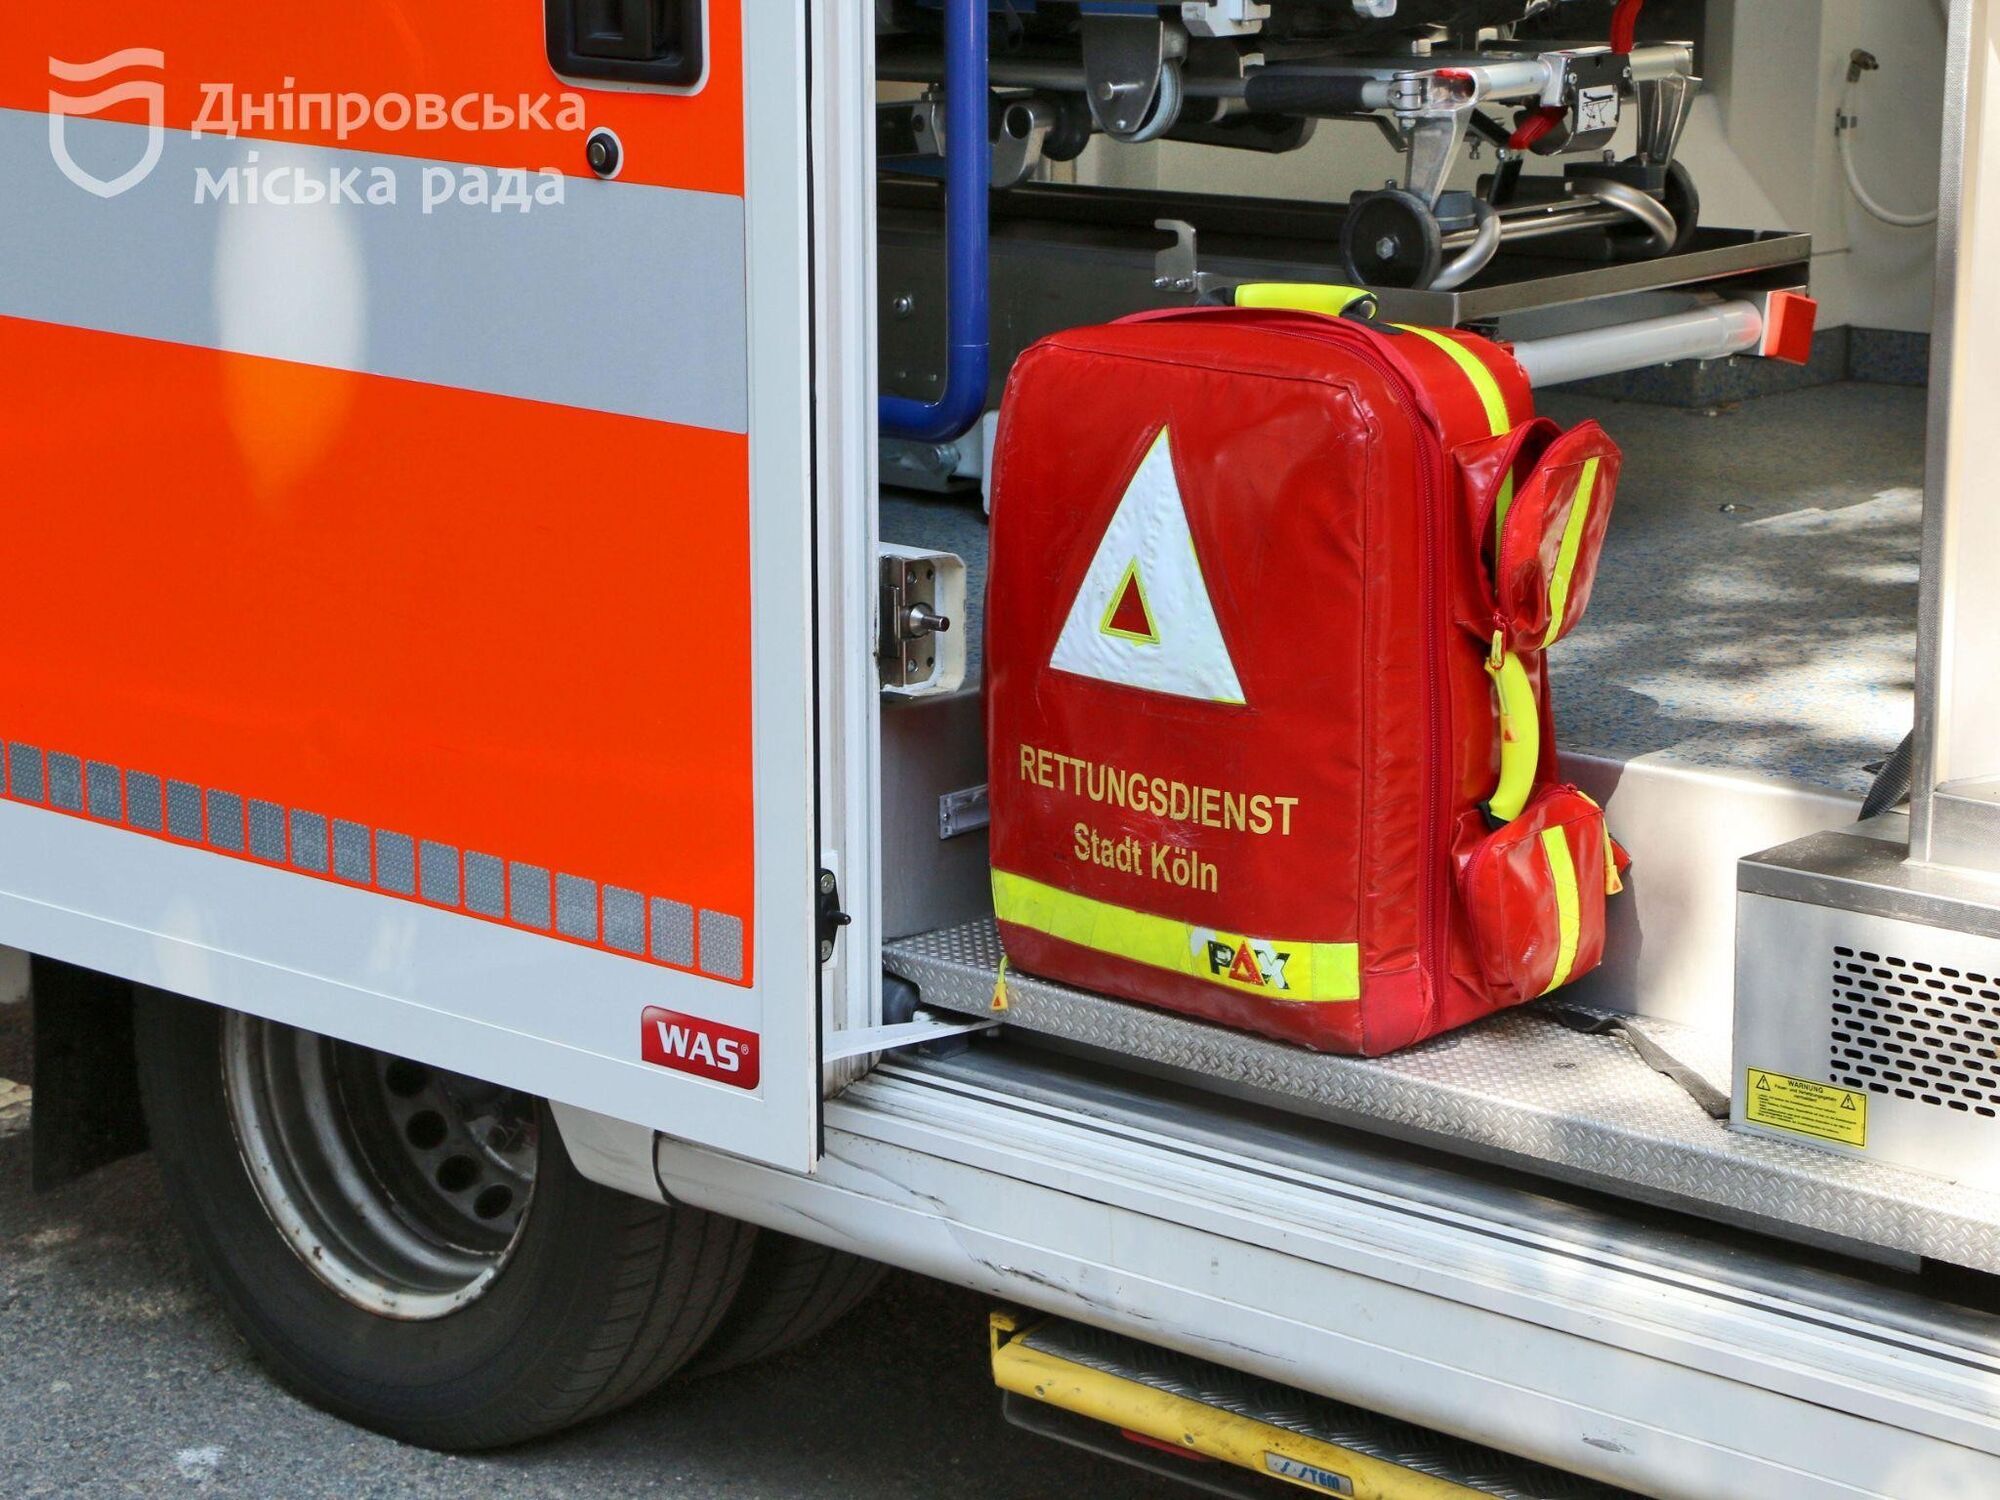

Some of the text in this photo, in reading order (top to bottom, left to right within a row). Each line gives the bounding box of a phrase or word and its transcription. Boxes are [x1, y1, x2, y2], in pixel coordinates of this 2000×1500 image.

[1019, 743, 1299, 836] RETTUNGSDIENST
[1073, 822, 1219, 893] Stadt Köln
[1207, 940, 1291, 990] PAX
[1787, 1079, 1824, 1094] WARNUNG
